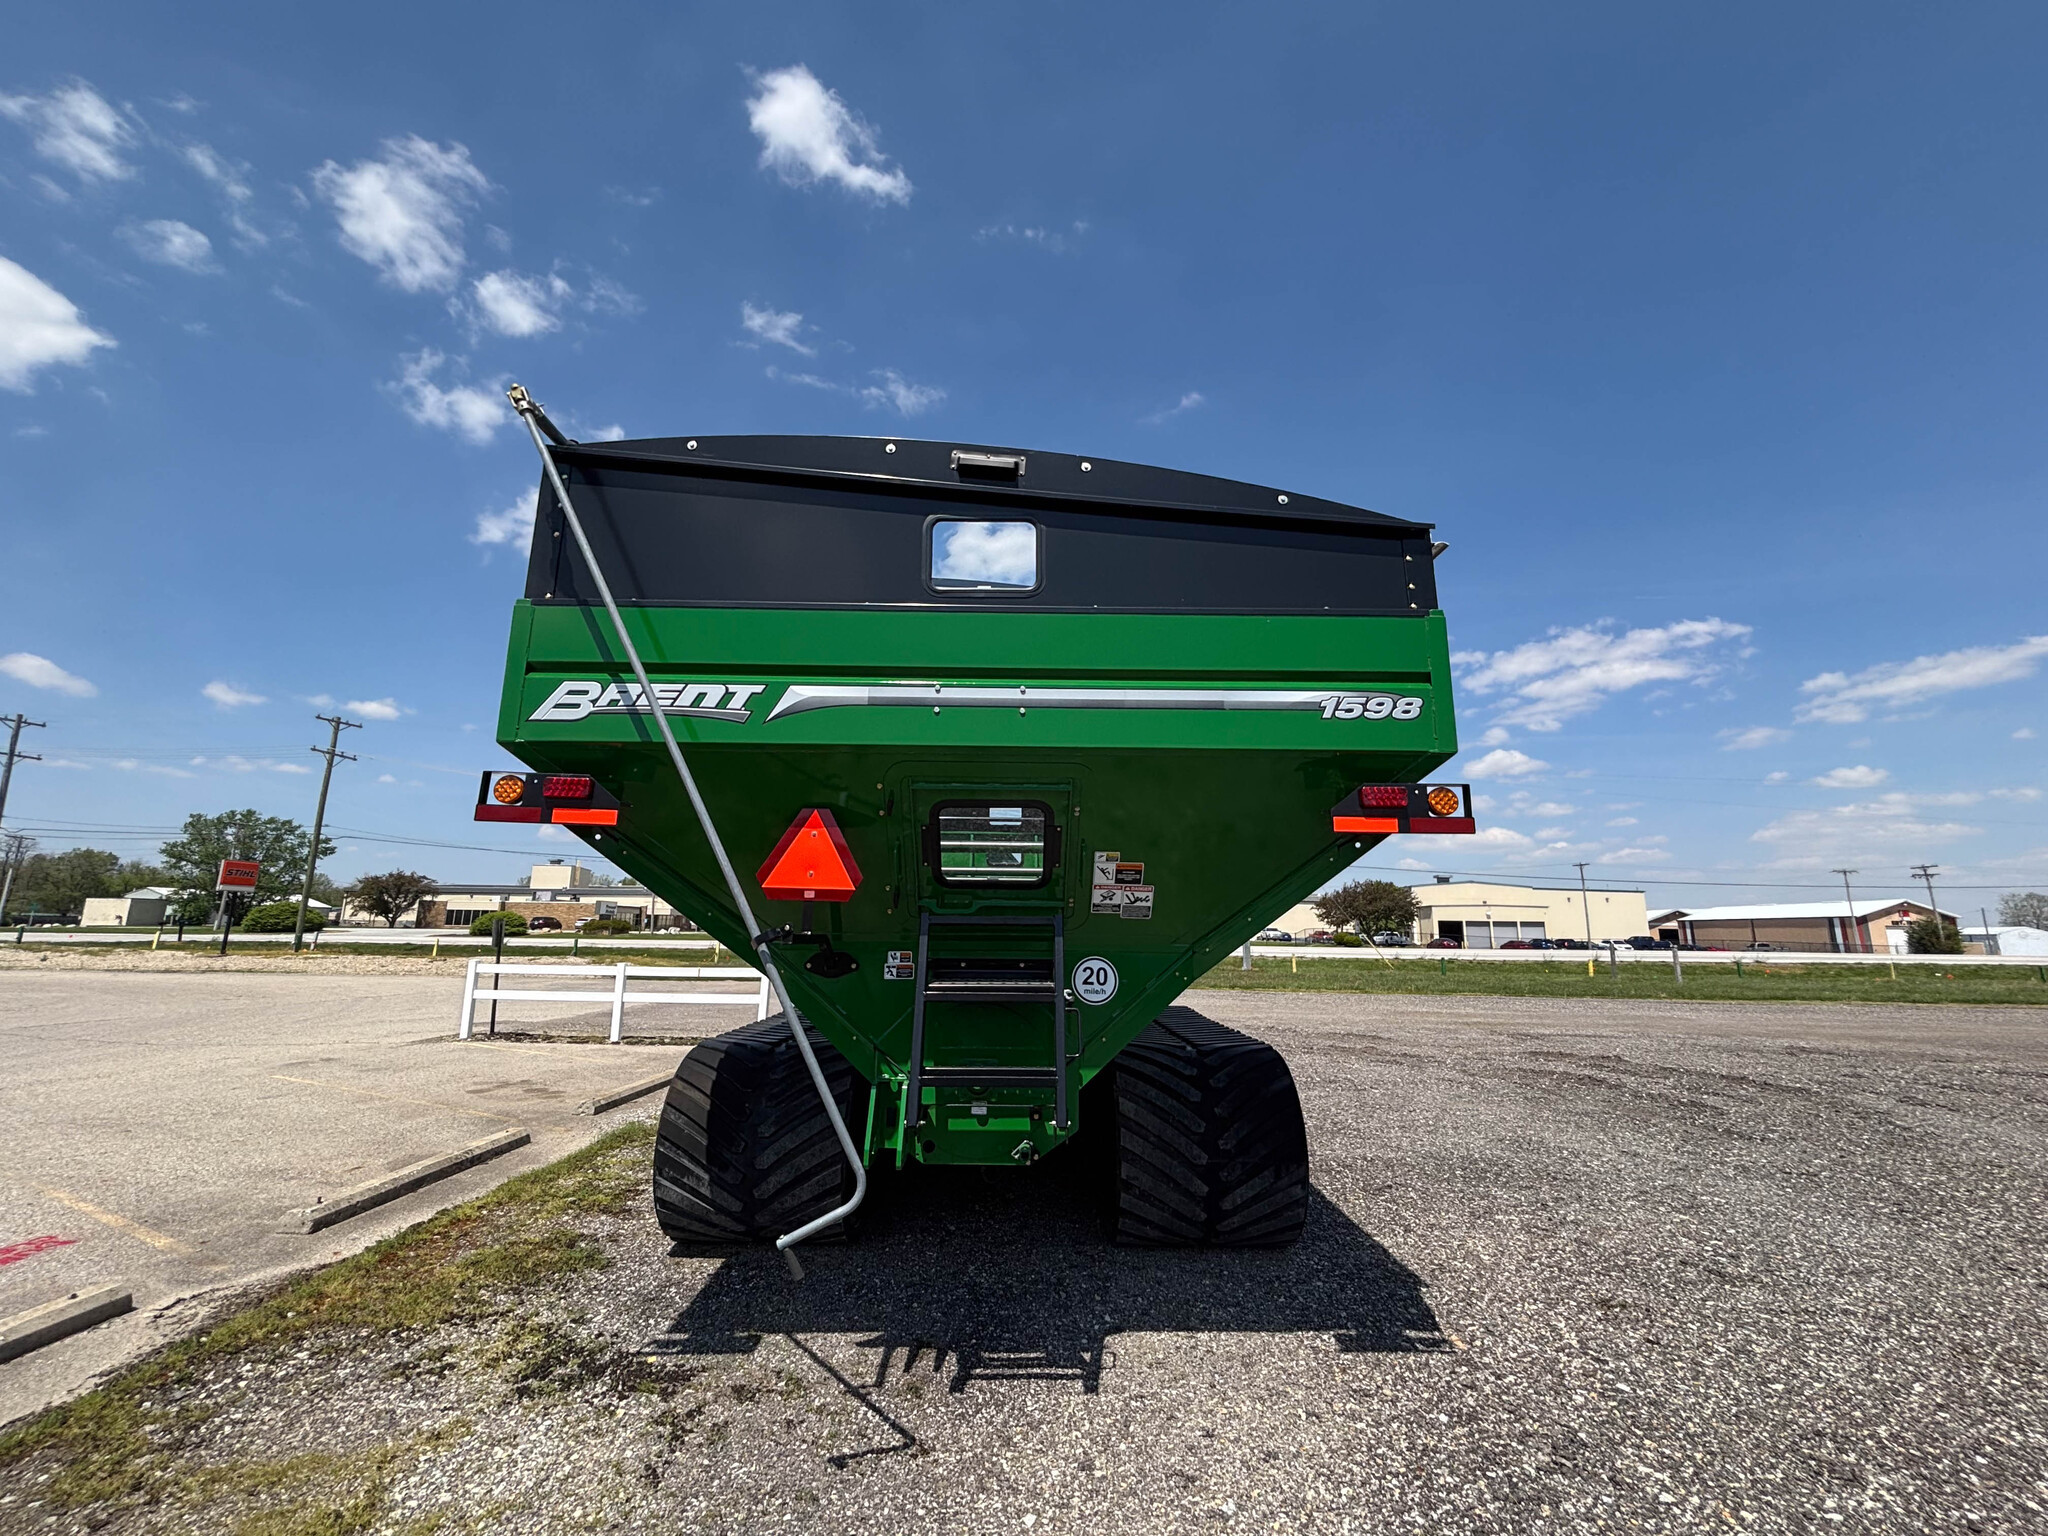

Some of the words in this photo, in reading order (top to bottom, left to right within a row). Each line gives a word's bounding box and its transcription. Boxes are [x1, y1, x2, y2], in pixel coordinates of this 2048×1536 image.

[527, 680, 768, 722] BRENT
[1319, 696, 1423, 720] 1598
[226, 869, 255, 877] STIHL
[1082, 966, 1108, 986] 20
